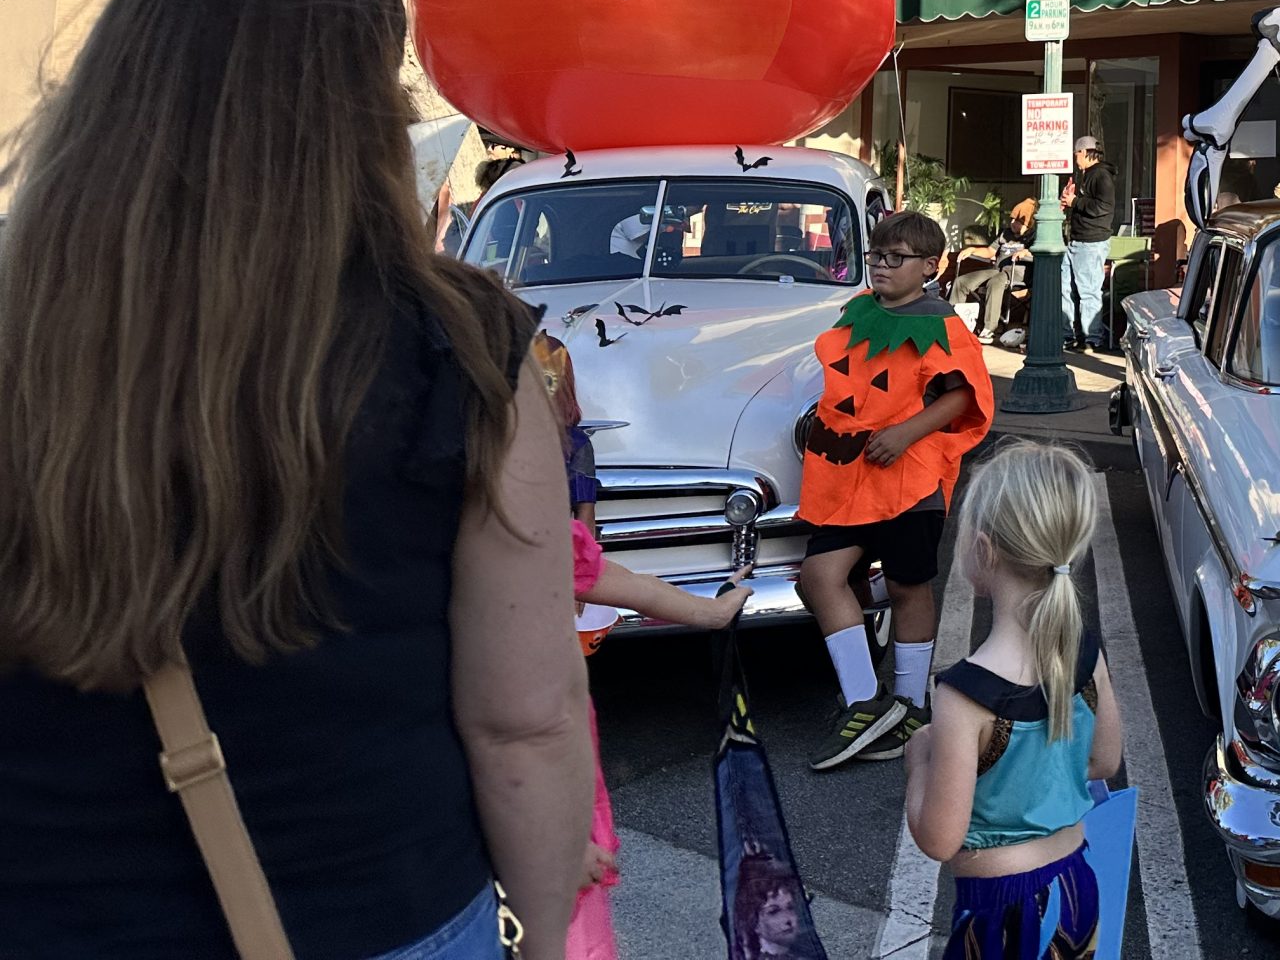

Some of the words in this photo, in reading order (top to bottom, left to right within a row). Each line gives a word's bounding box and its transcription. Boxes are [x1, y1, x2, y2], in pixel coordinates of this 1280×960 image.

[1030, 2, 1040, 18] 2
[1041, 8, 1067, 19] PARKING
[1028, 99, 1067, 108] TEMPORARY
[1027, 108, 1041, 120] NO
[1026, 120, 1069, 132] PARKING
[1030, 160, 1065, 169] TOW-AWAY
